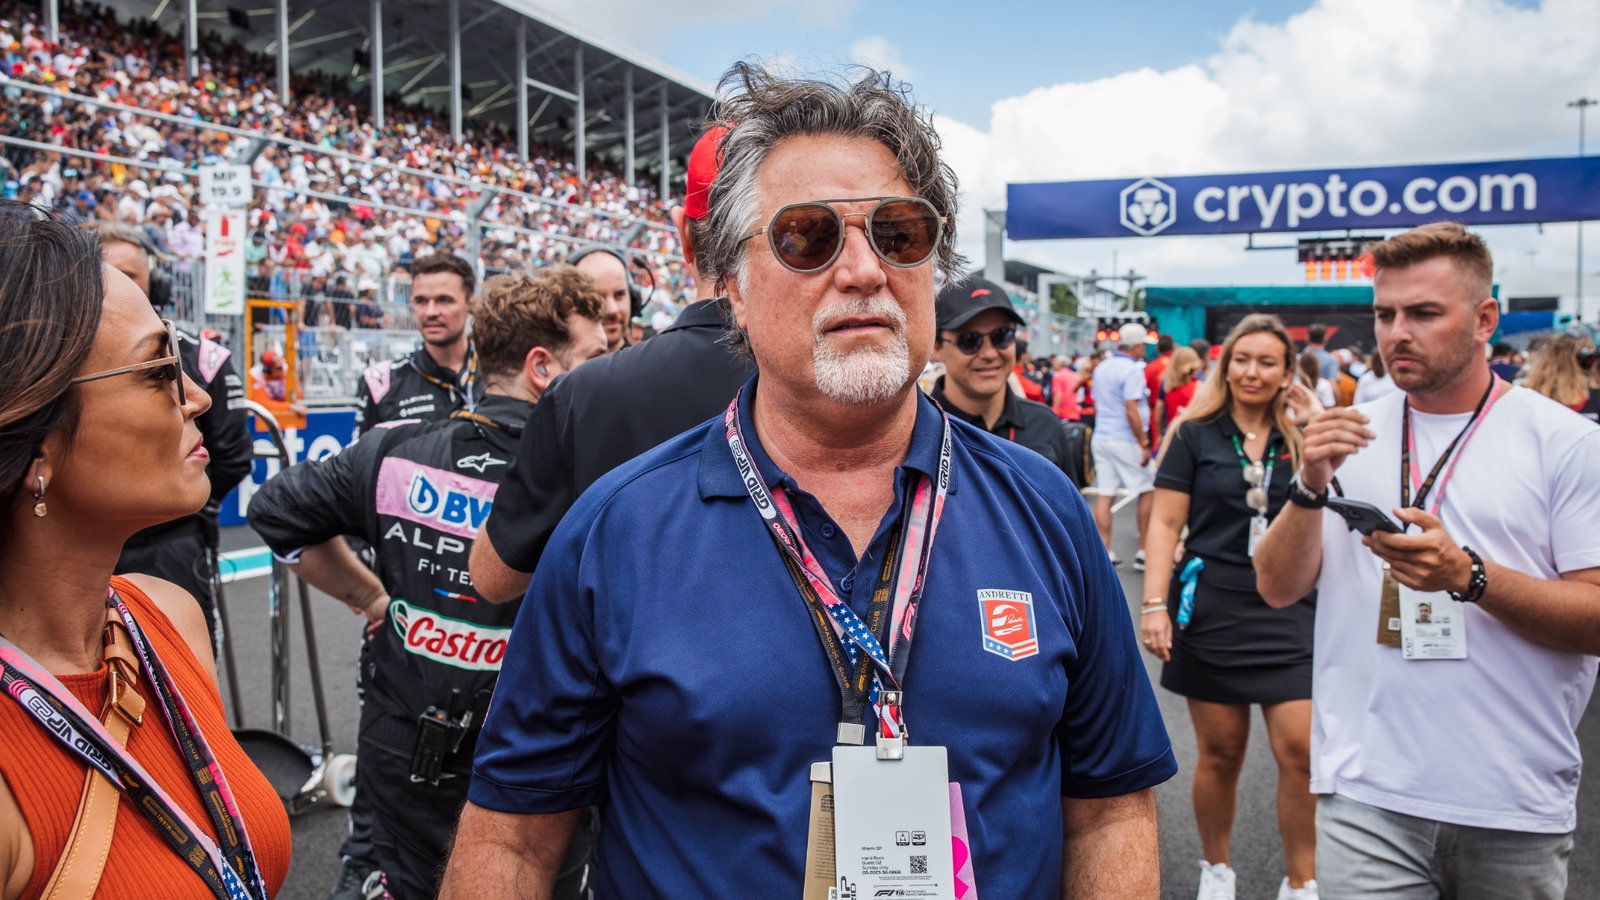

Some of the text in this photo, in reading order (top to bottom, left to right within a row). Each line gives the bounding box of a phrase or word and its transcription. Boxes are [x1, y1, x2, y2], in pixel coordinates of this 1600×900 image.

[1194, 173, 1537, 229] crypto.com
[747, 477, 769, 510] GRID
[448, 568, 474, 586] TE
[980, 590, 1029, 602] ANDRETTI
